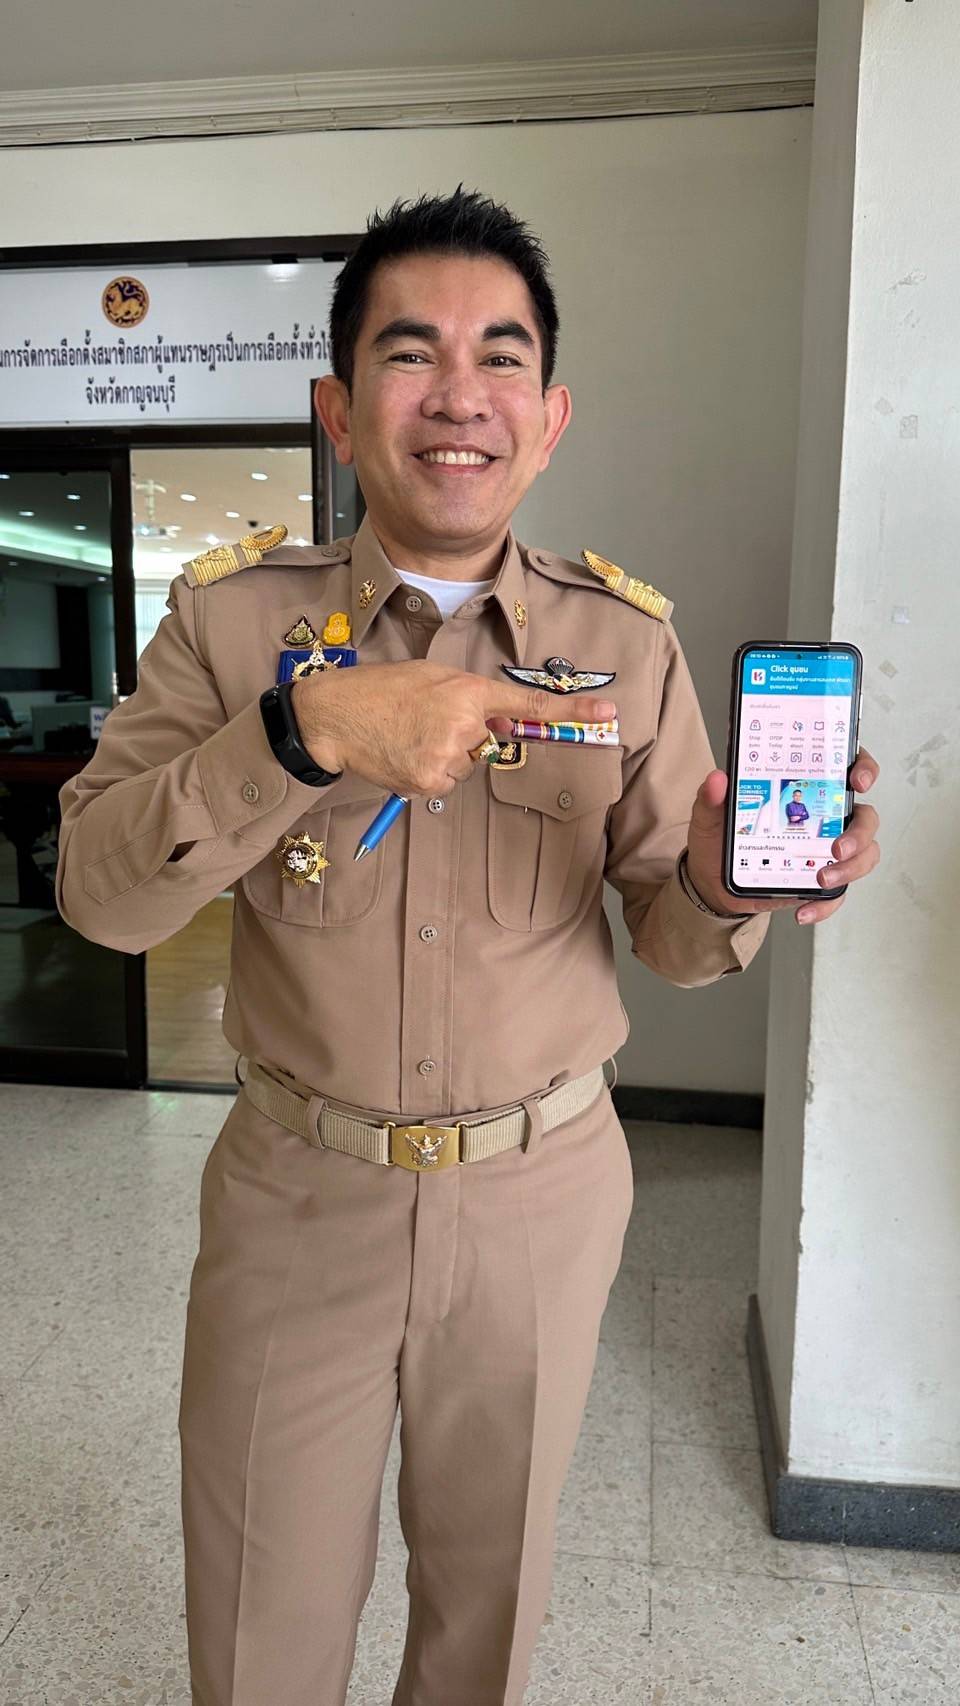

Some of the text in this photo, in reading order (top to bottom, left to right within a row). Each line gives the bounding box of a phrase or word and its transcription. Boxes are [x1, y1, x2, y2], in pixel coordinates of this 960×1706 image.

[86, 375, 176, 412] จังหวัดกาญจนบุรี
[770, 665, 788, 673] Click
